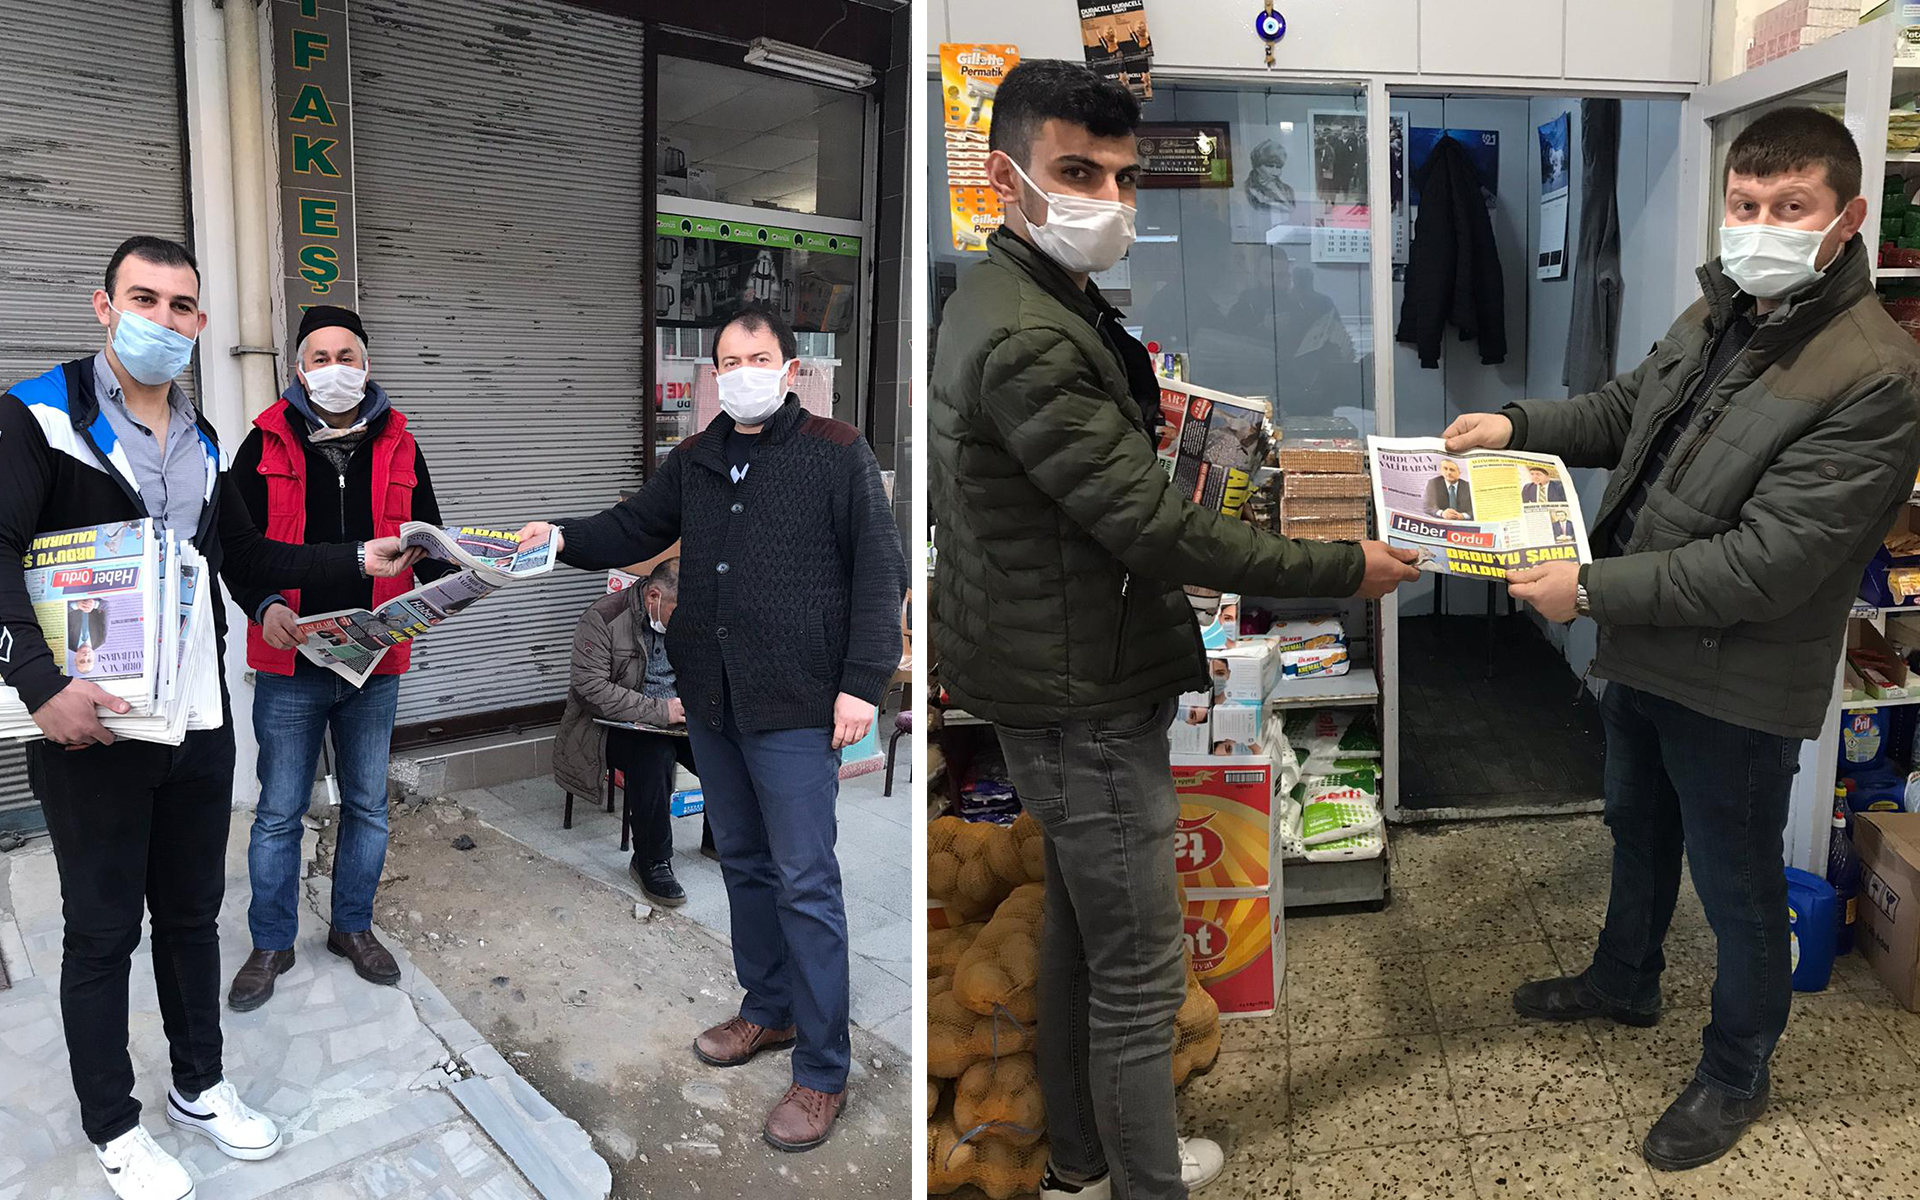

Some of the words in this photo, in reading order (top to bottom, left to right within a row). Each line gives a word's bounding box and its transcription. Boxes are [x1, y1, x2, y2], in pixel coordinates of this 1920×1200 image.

[1081, 4, 1111, 15] DURACELL
[1111, 0, 1142, 10] DURACELL
[956, 52, 1005, 66] Gillette
[961, 65, 1003, 77] Permatik
[298, 197, 345, 311] EŞ
[33, 530, 98, 547] KALDIRAN
[461, 526, 522, 543] ADAM
[1397, 517, 1446, 538] Haber
[1451, 532, 1484, 545] Ordu
[36, 546, 96, 567] ORDU'YU
[1446, 548, 1521, 565] ORDU'YU
[1525, 546, 1577, 564] ŞAHA
[61, 569, 90, 585] Ordu
[93, 568, 134, 585] Haber
[411, 600, 436, 620] Haber
[1854, 715, 1871, 731] Pril
